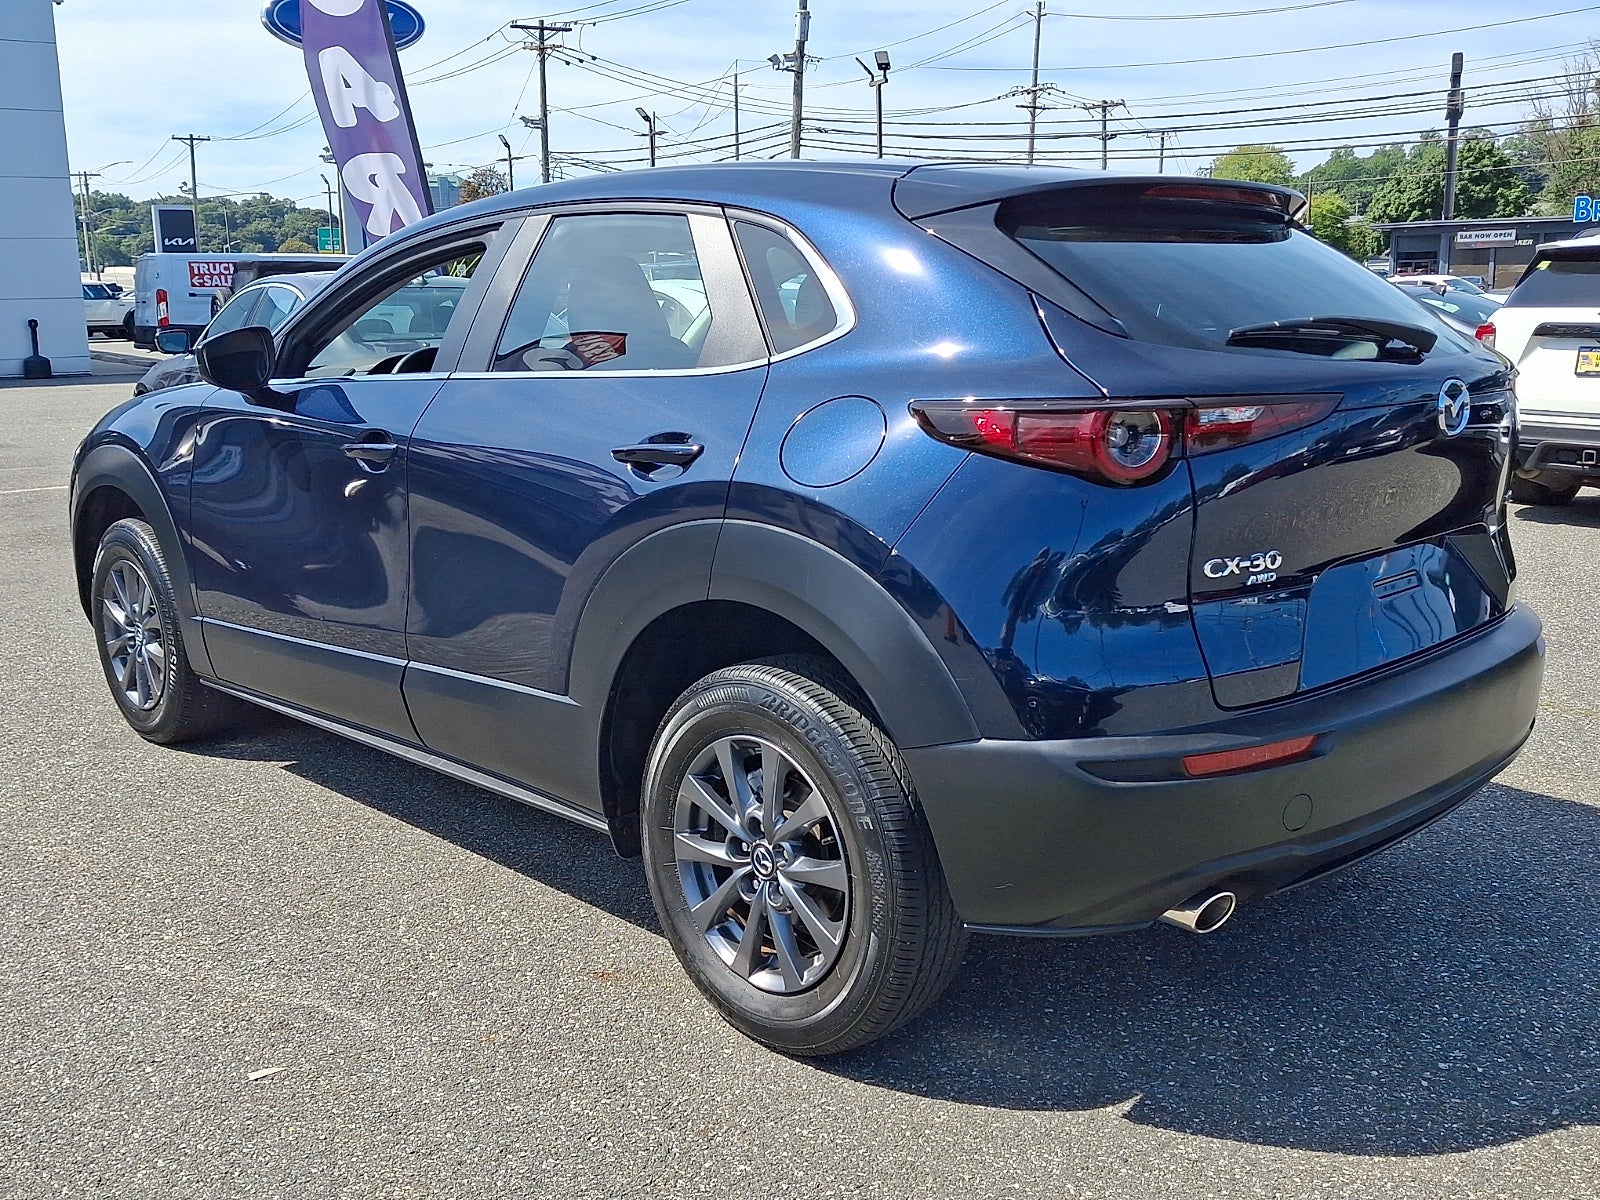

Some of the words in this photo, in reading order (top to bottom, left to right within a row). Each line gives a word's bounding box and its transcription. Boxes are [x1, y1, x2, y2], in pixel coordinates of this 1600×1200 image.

[164, 237, 194, 246] KIA
[1203, 550, 1283, 578] CX-30
[1246, 572, 1277, 586] AWD
[757, 692, 874, 831] BRIDGESTONE
